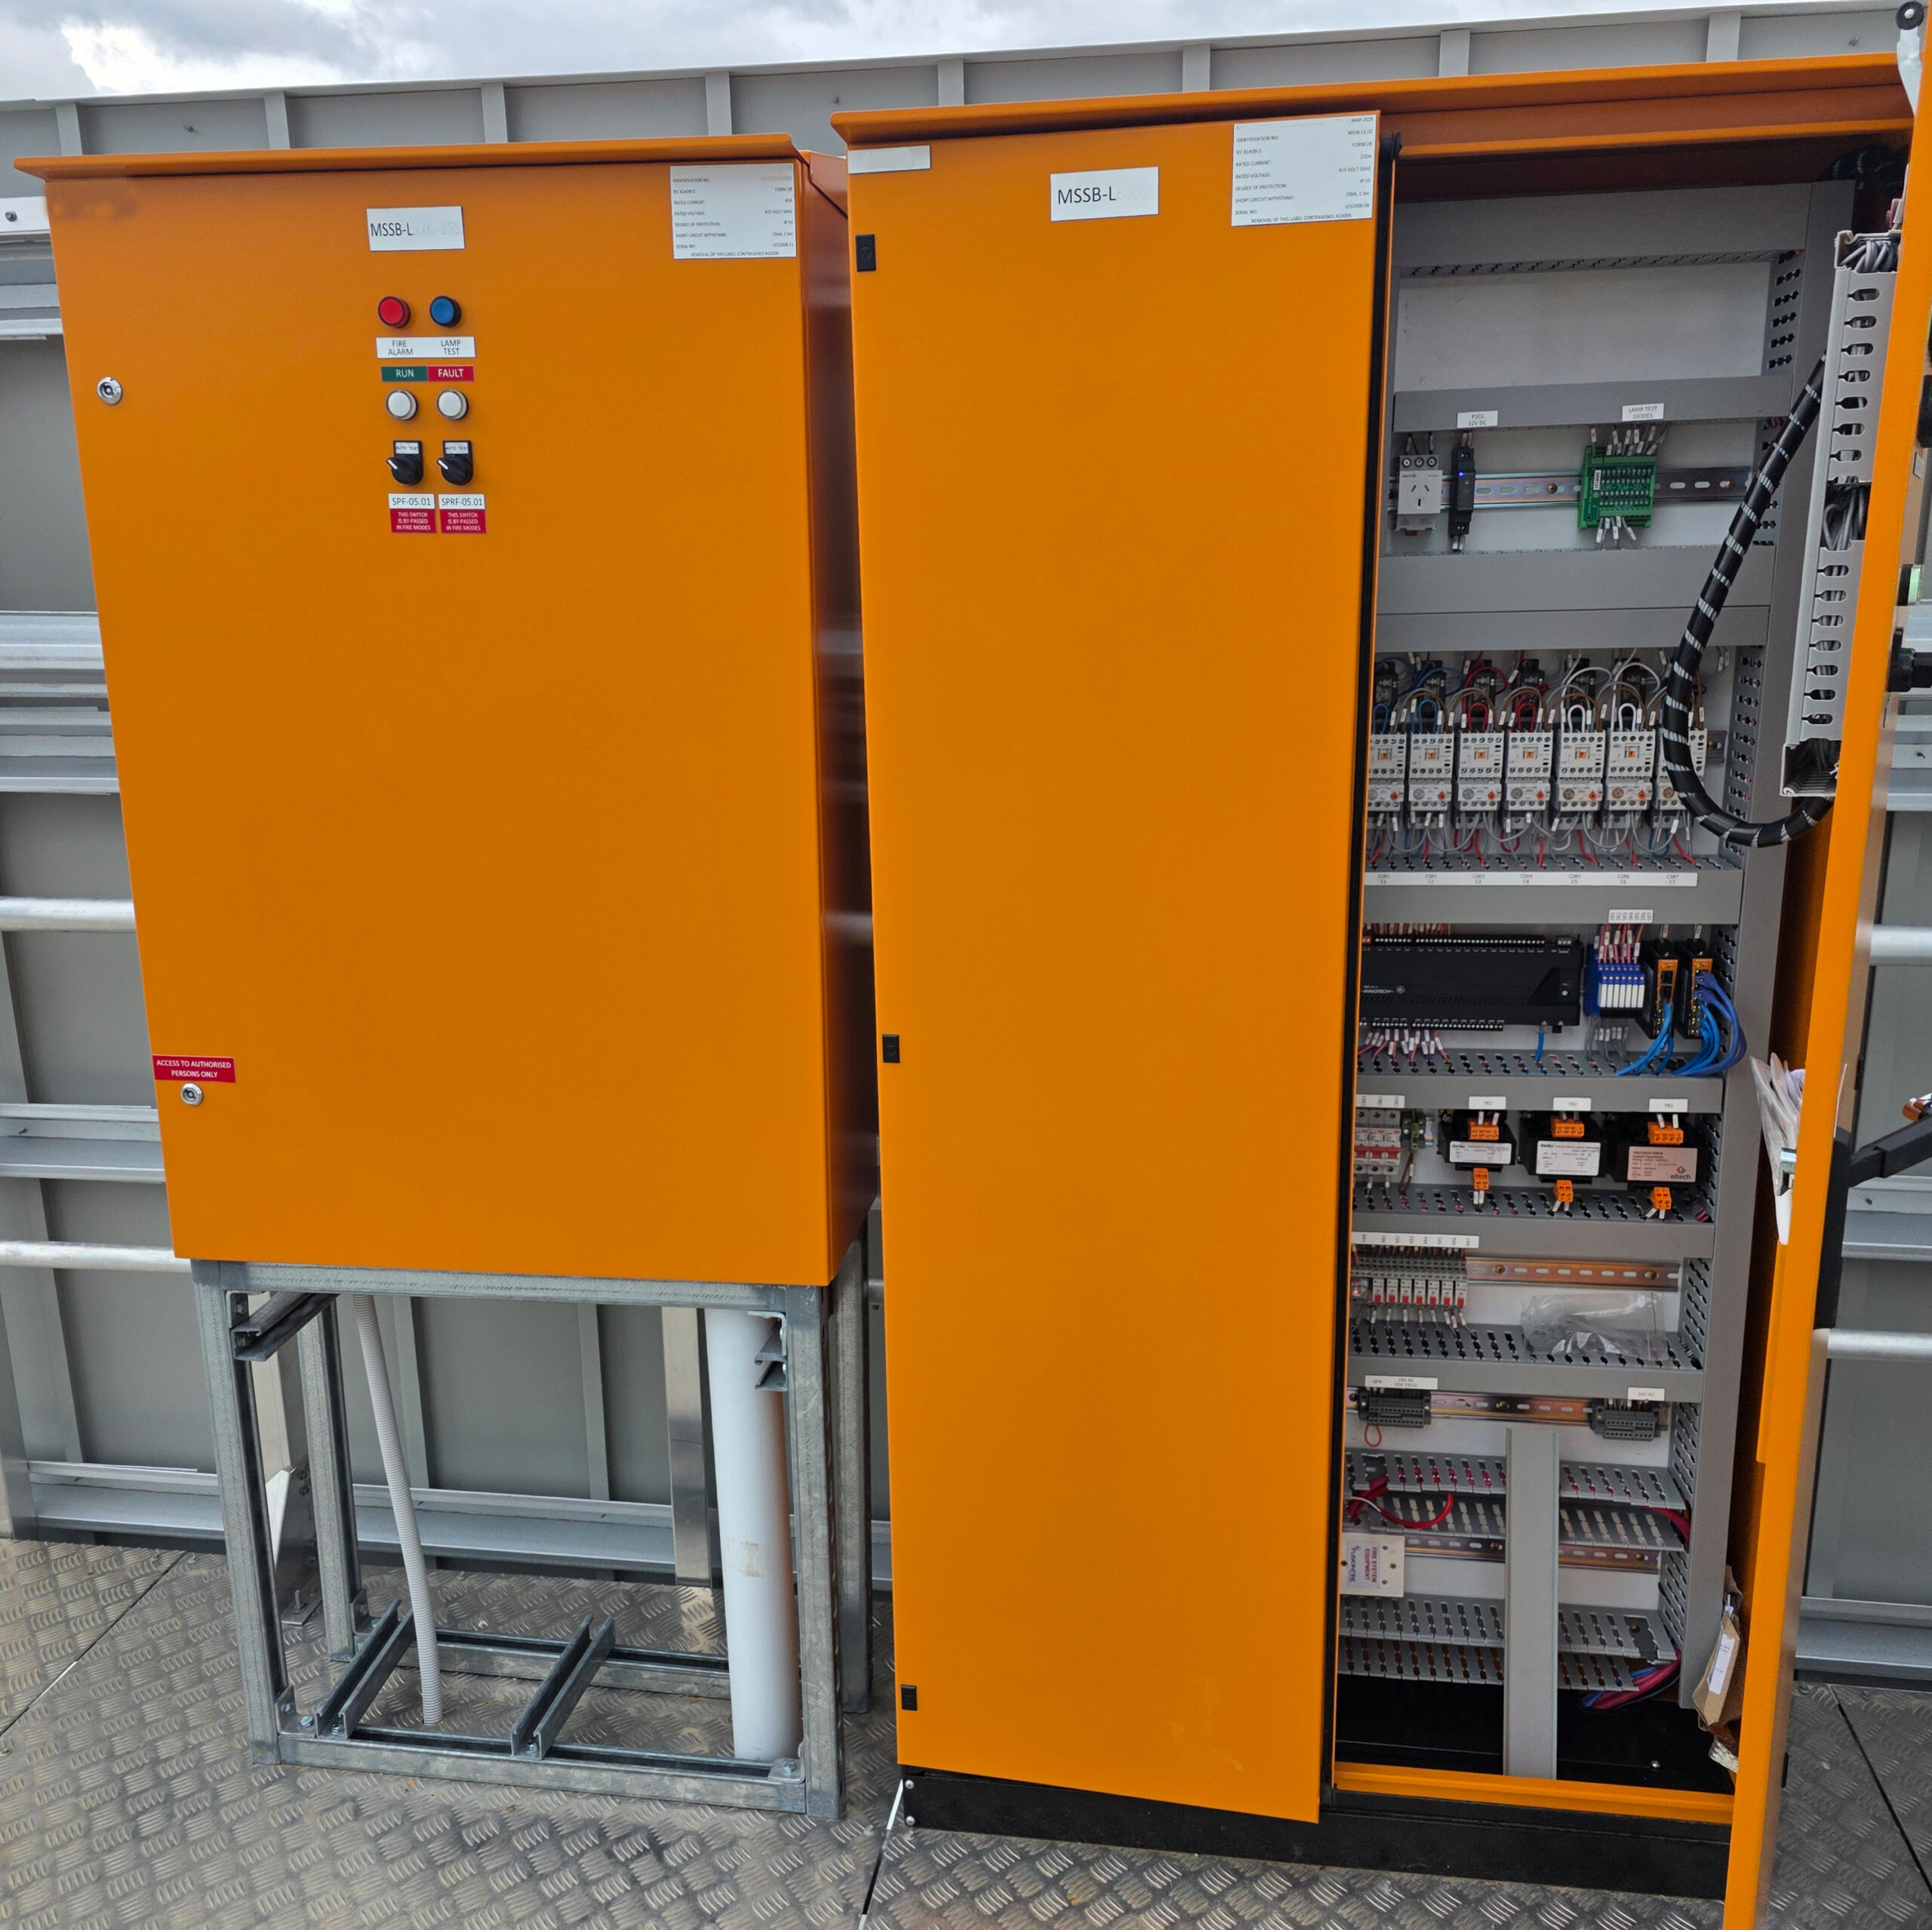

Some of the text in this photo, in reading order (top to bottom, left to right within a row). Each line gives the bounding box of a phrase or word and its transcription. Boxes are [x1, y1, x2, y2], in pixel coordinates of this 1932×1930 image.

[395, 369, 414, 377] RUN
[438, 368, 463, 377] FAULT
[392, 497, 431, 506] SPF-05.01
